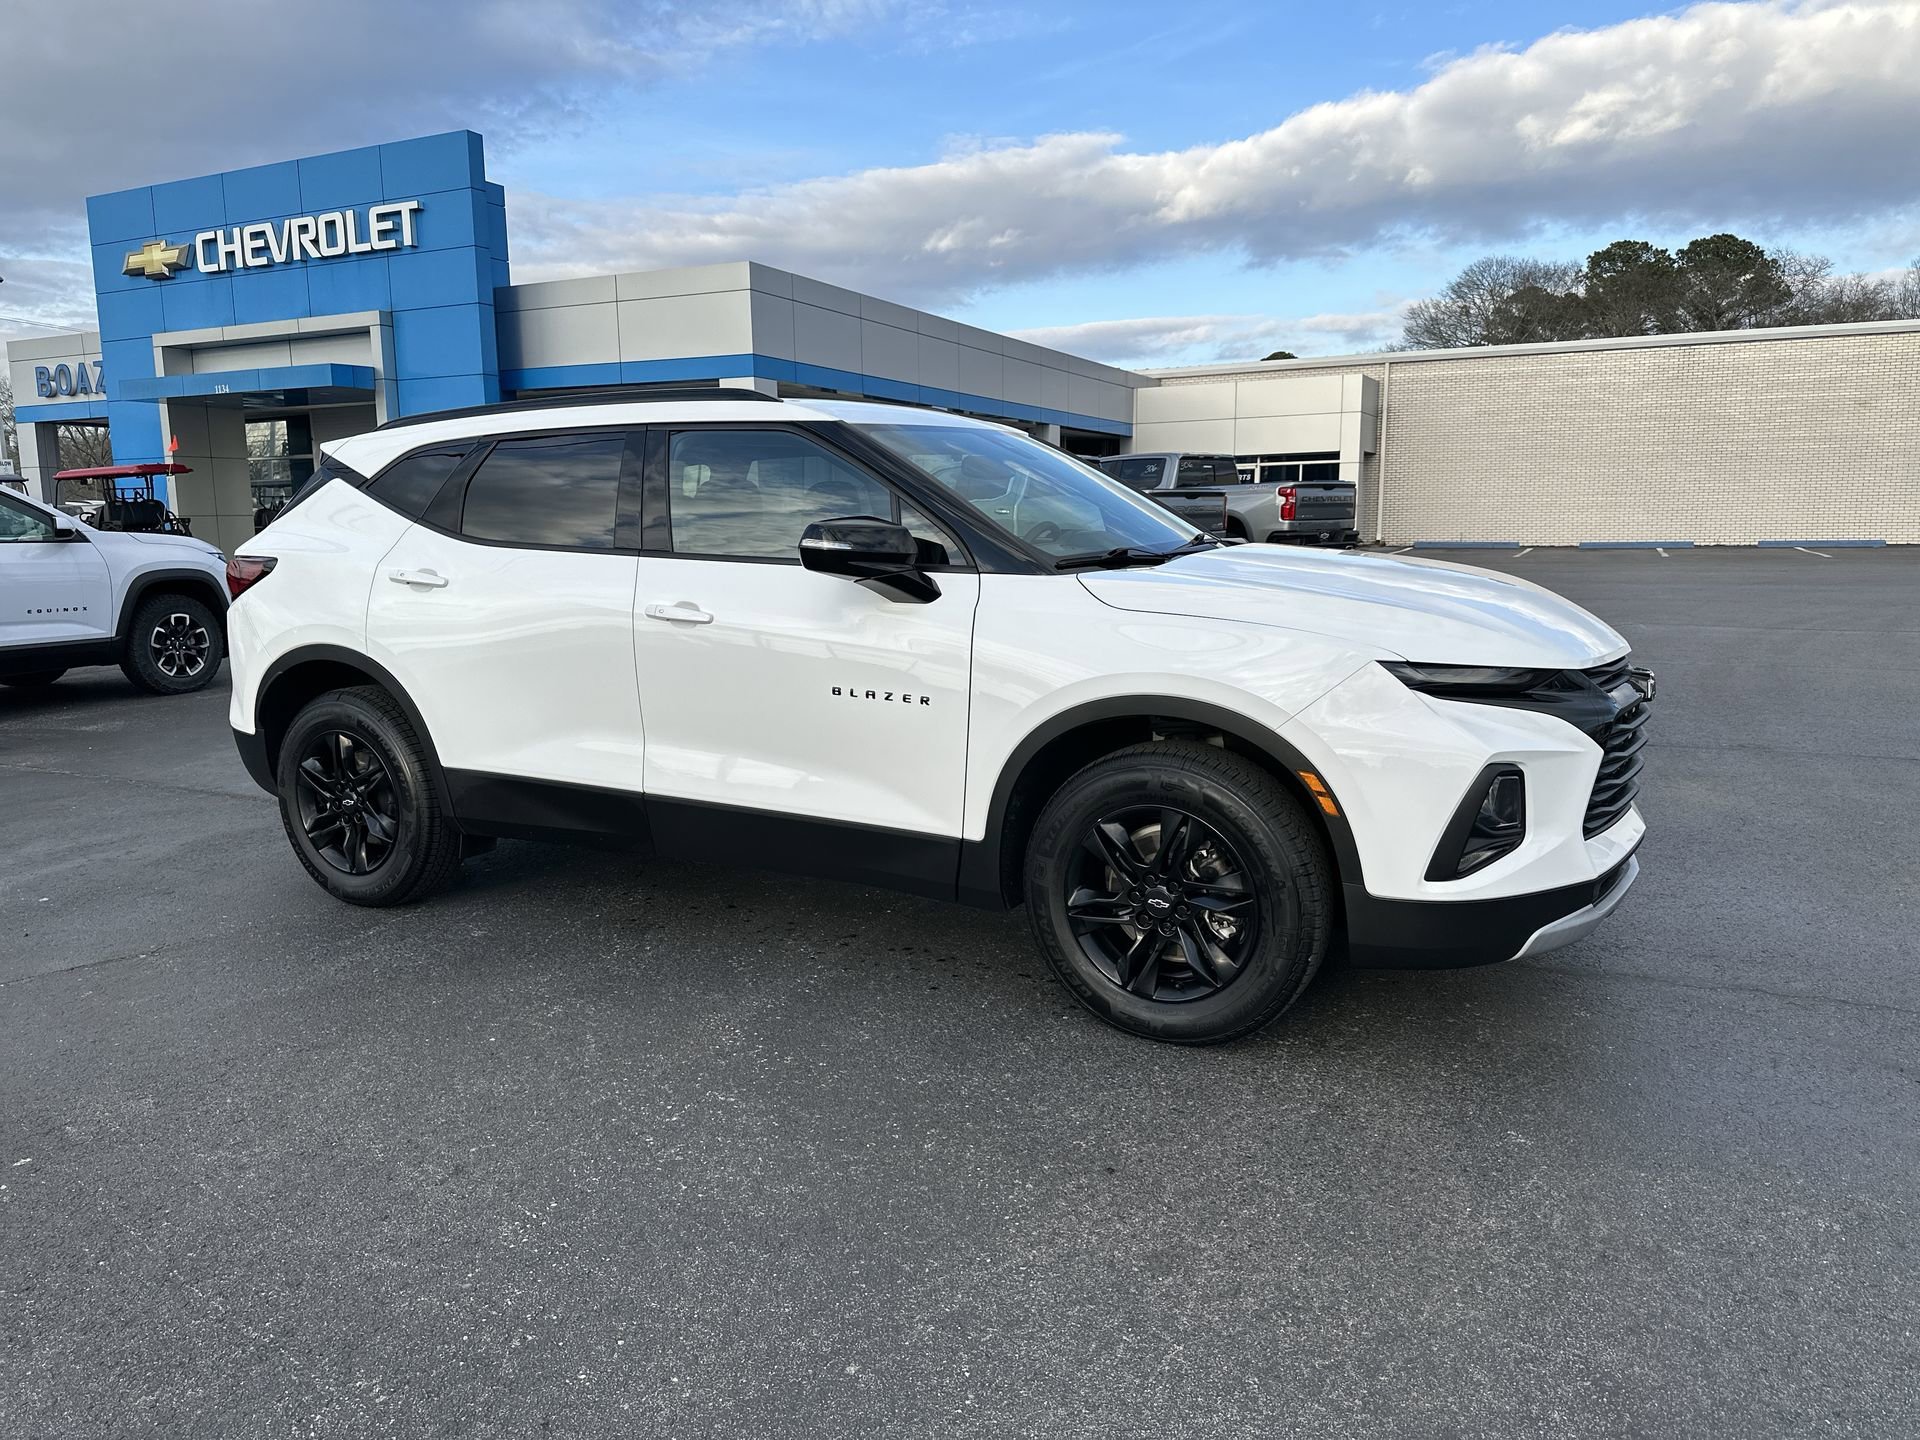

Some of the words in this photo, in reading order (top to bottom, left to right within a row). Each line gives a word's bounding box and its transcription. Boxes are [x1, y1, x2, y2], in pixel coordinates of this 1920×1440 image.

[195, 200, 420, 273] CHEVROLET
[35, 361, 106, 397] BOAZ
[215, 384, 230, 394] 1134
[1239, 473, 1251, 481] RTS
[1301, 495, 1353, 503] CHEVROLET
[27, 606, 88, 615] EQUINOX
[832, 686, 930, 706] BLAZER
